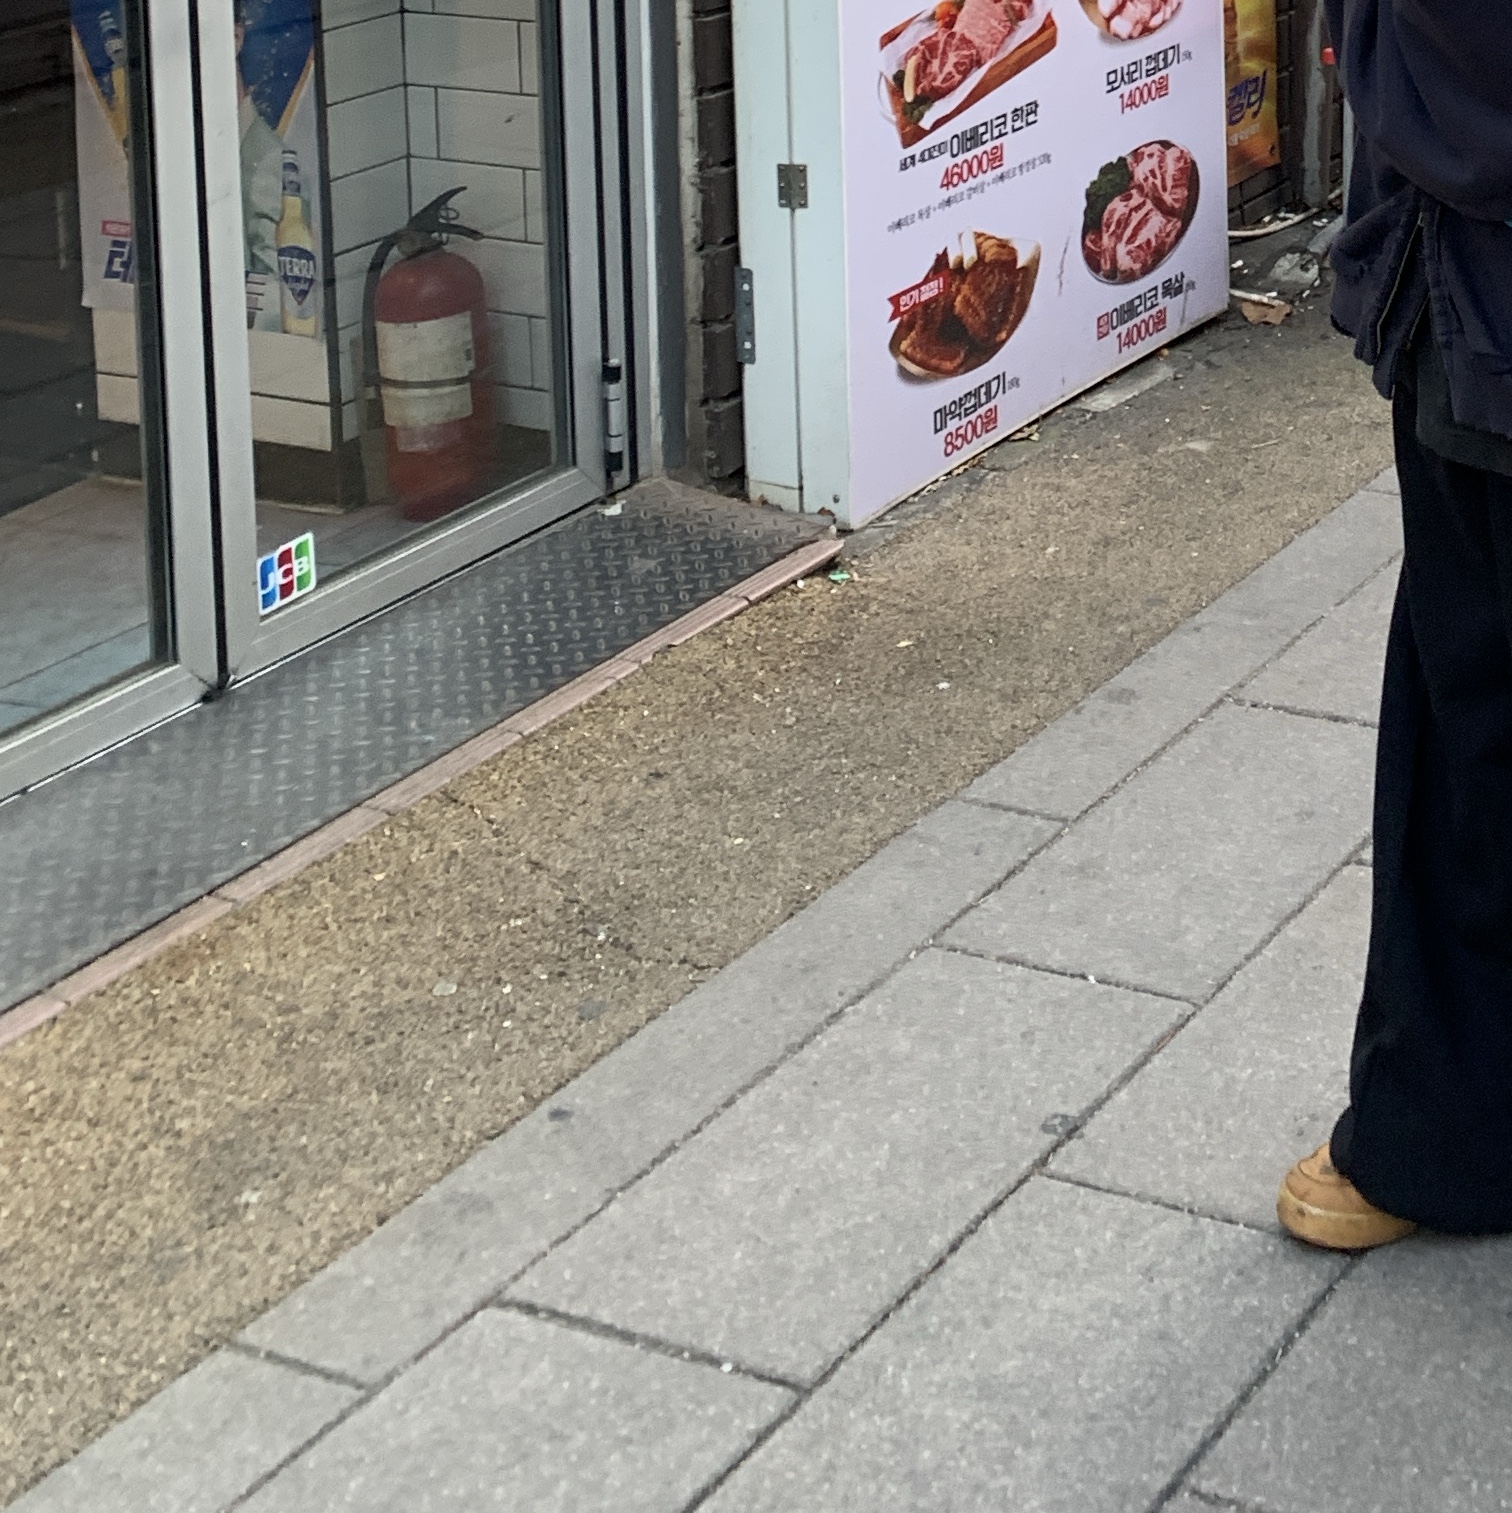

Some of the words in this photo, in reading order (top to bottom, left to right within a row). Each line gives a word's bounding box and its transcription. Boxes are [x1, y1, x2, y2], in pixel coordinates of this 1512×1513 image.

[1106, 59, 1143, 95] 모서리
[1145, 43, 1180, 79] 껍데기
[1119, 73, 1170, 115] 14000원
[950, 113, 1009, 159] 이베리코
[1011, 100, 1040, 134] 한판
[939, 143, 1005, 191] 46000원
[899, 290, 920, 313] 인기
[1110, 285, 1159, 331] 이베리코
[1161, 271, 1185, 300] 목살
[1116, 306, 1168, 355] 14000원
[933, 371, 1006, 435] 마약껍데기
[943, 405, 998, 458] 8500원
[261, 554, 310, 595] JCB
